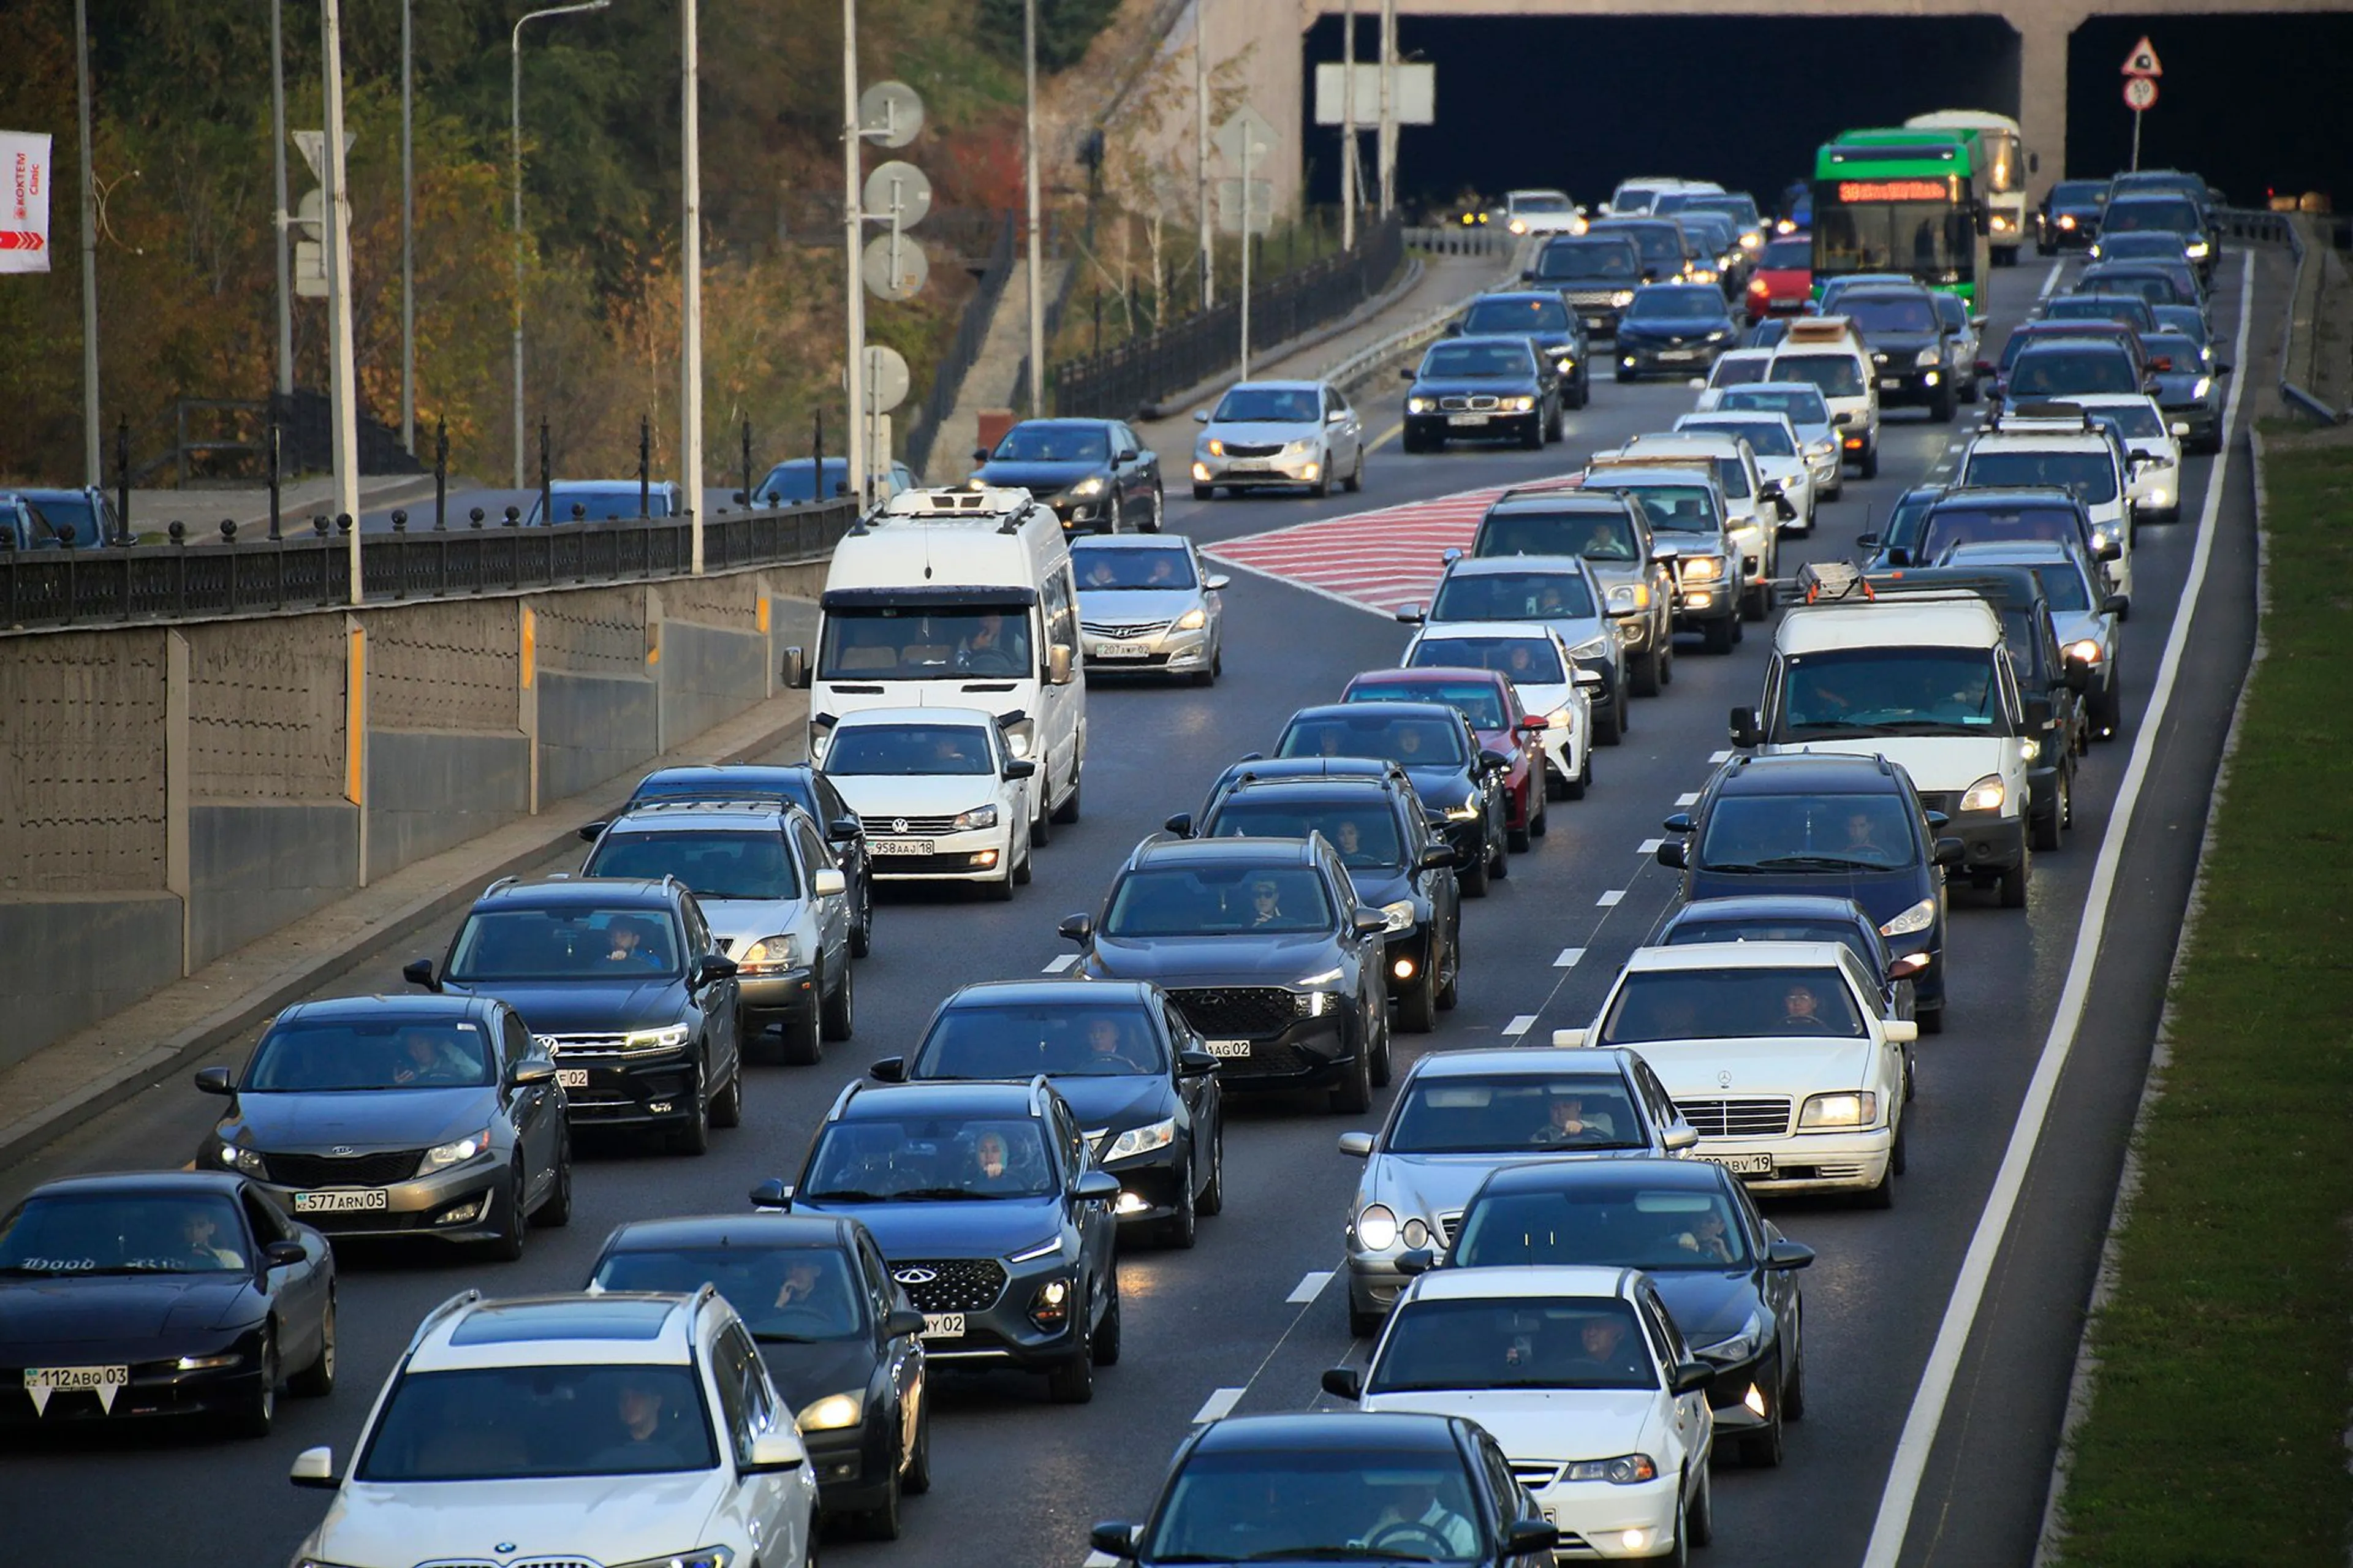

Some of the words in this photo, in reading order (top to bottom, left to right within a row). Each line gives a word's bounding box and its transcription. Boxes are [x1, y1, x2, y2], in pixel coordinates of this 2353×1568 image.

[29, 163, 39, 195] Clinic
[876, 843, 916, 854] 958AAJ
[919, 843, 932, 854] 18
[1233, 1042, 1249, 1055] 02
[569, 1071, 586, 1085] 02
[1752, 1156, 1770, 1170] 19
[309, 1194, 363, 1209] 577ARN
[366, 1192, 384, 1207] 05
[944, 1316, 963, 1331] 02
[40, 1369, 102, 1386] 112ABQ
[105, 1368, 126, 1385] 03
